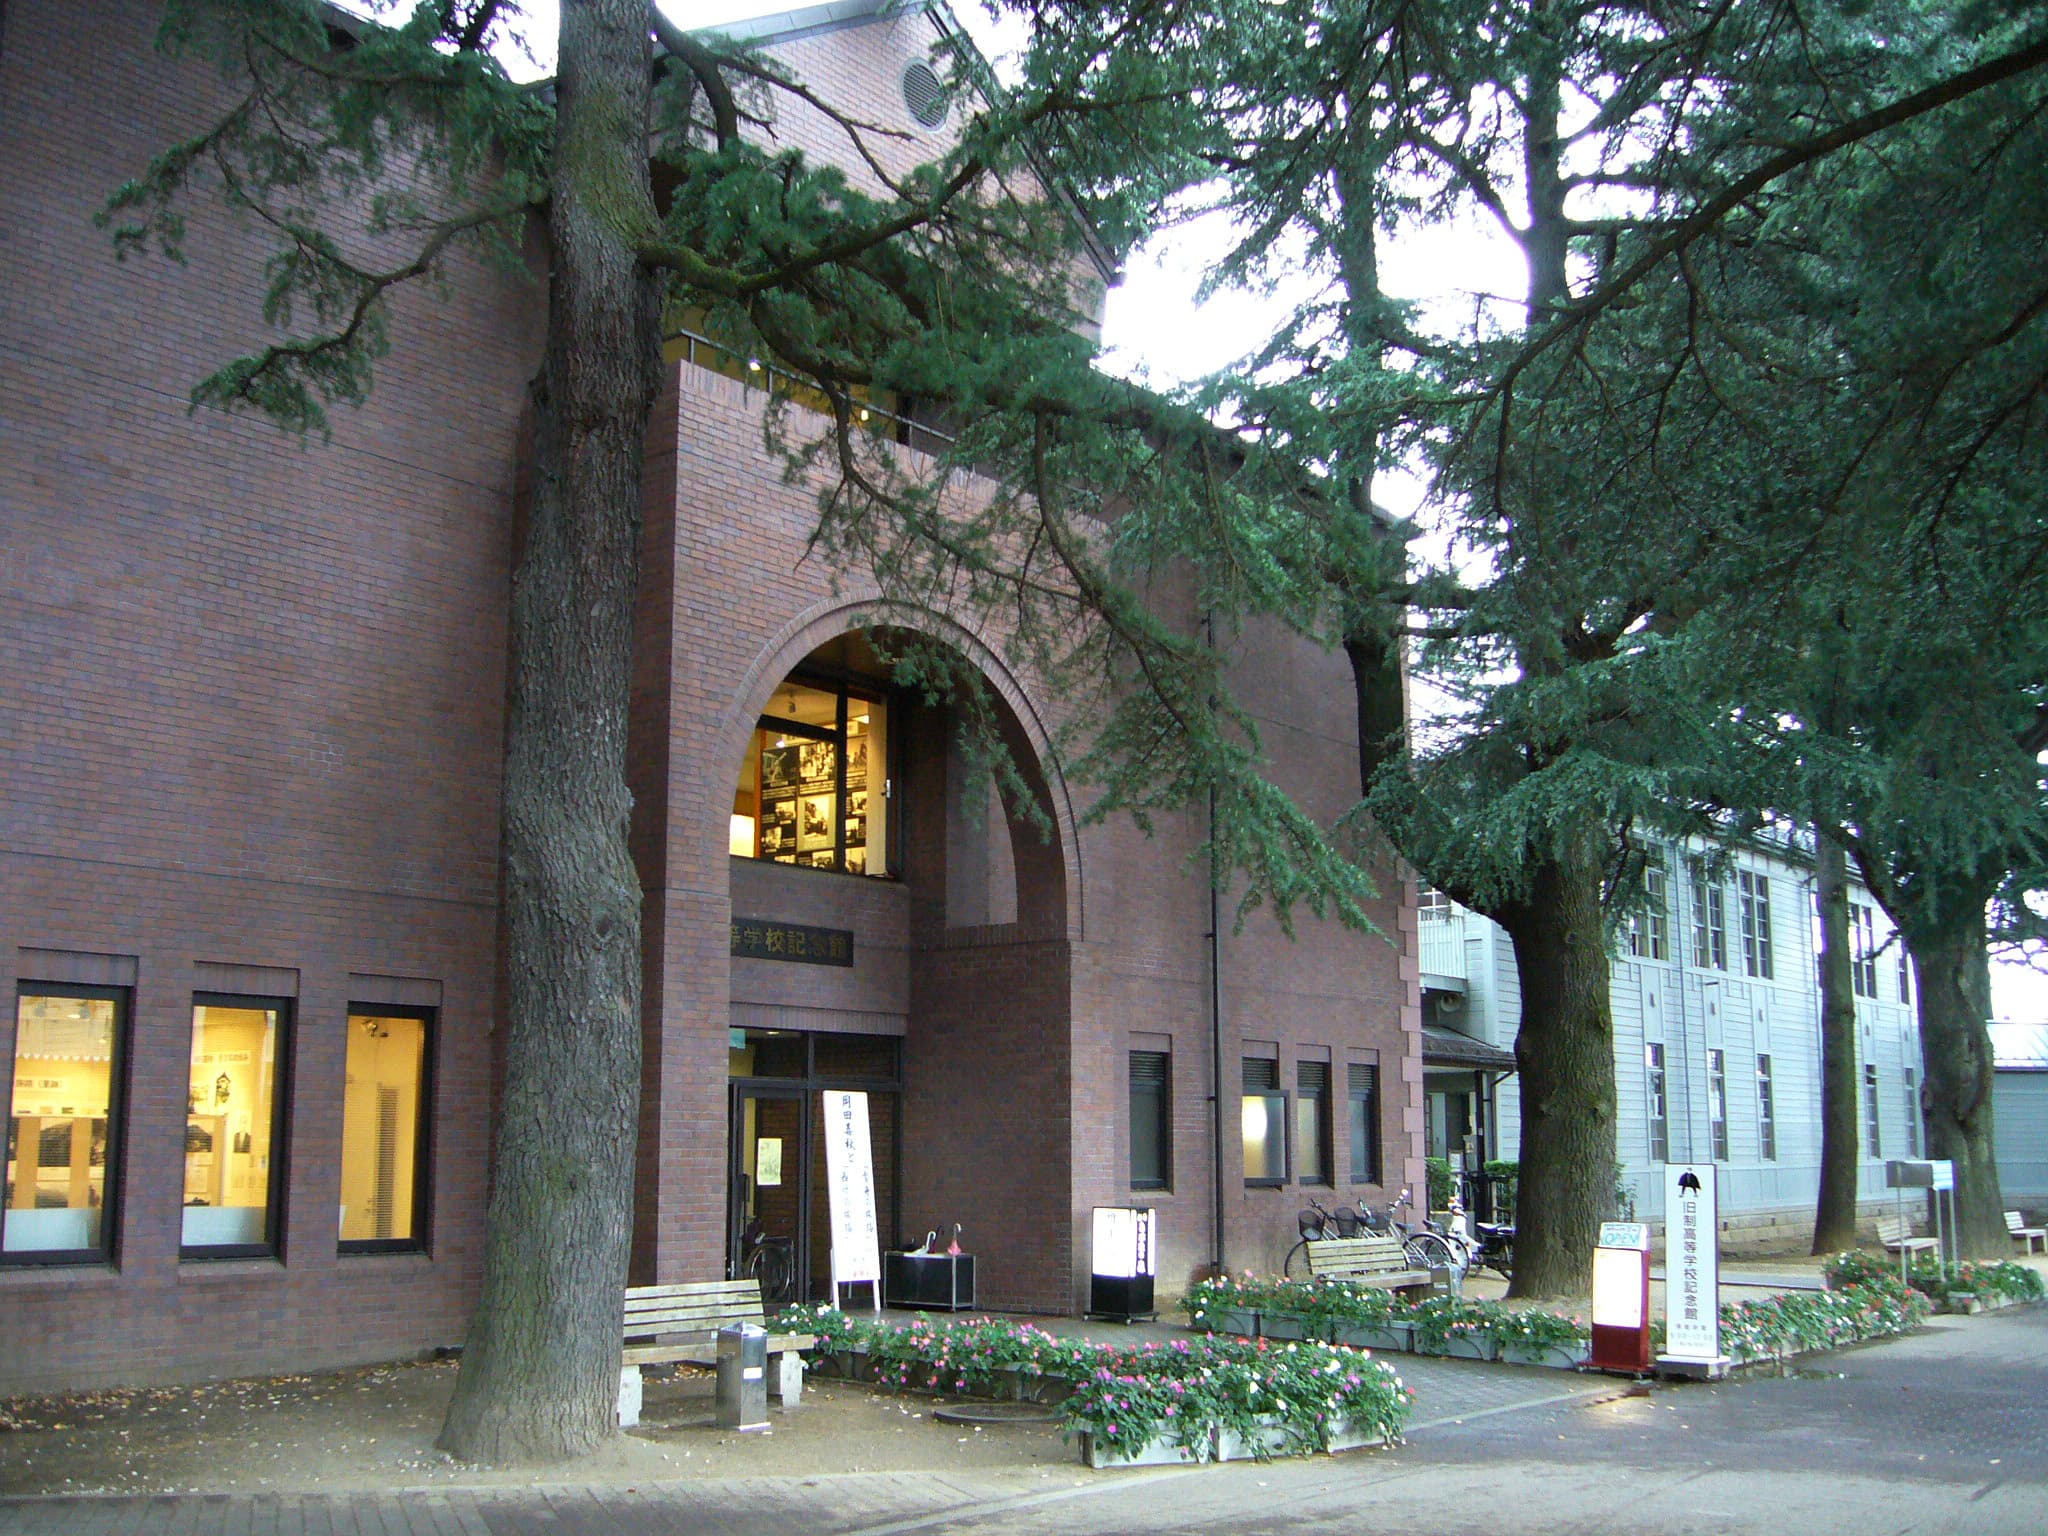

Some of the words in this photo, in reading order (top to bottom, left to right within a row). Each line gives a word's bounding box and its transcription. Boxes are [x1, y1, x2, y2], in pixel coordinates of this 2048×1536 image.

[1683, 1201, 1698, 1320] 旧制高等学校記念館
